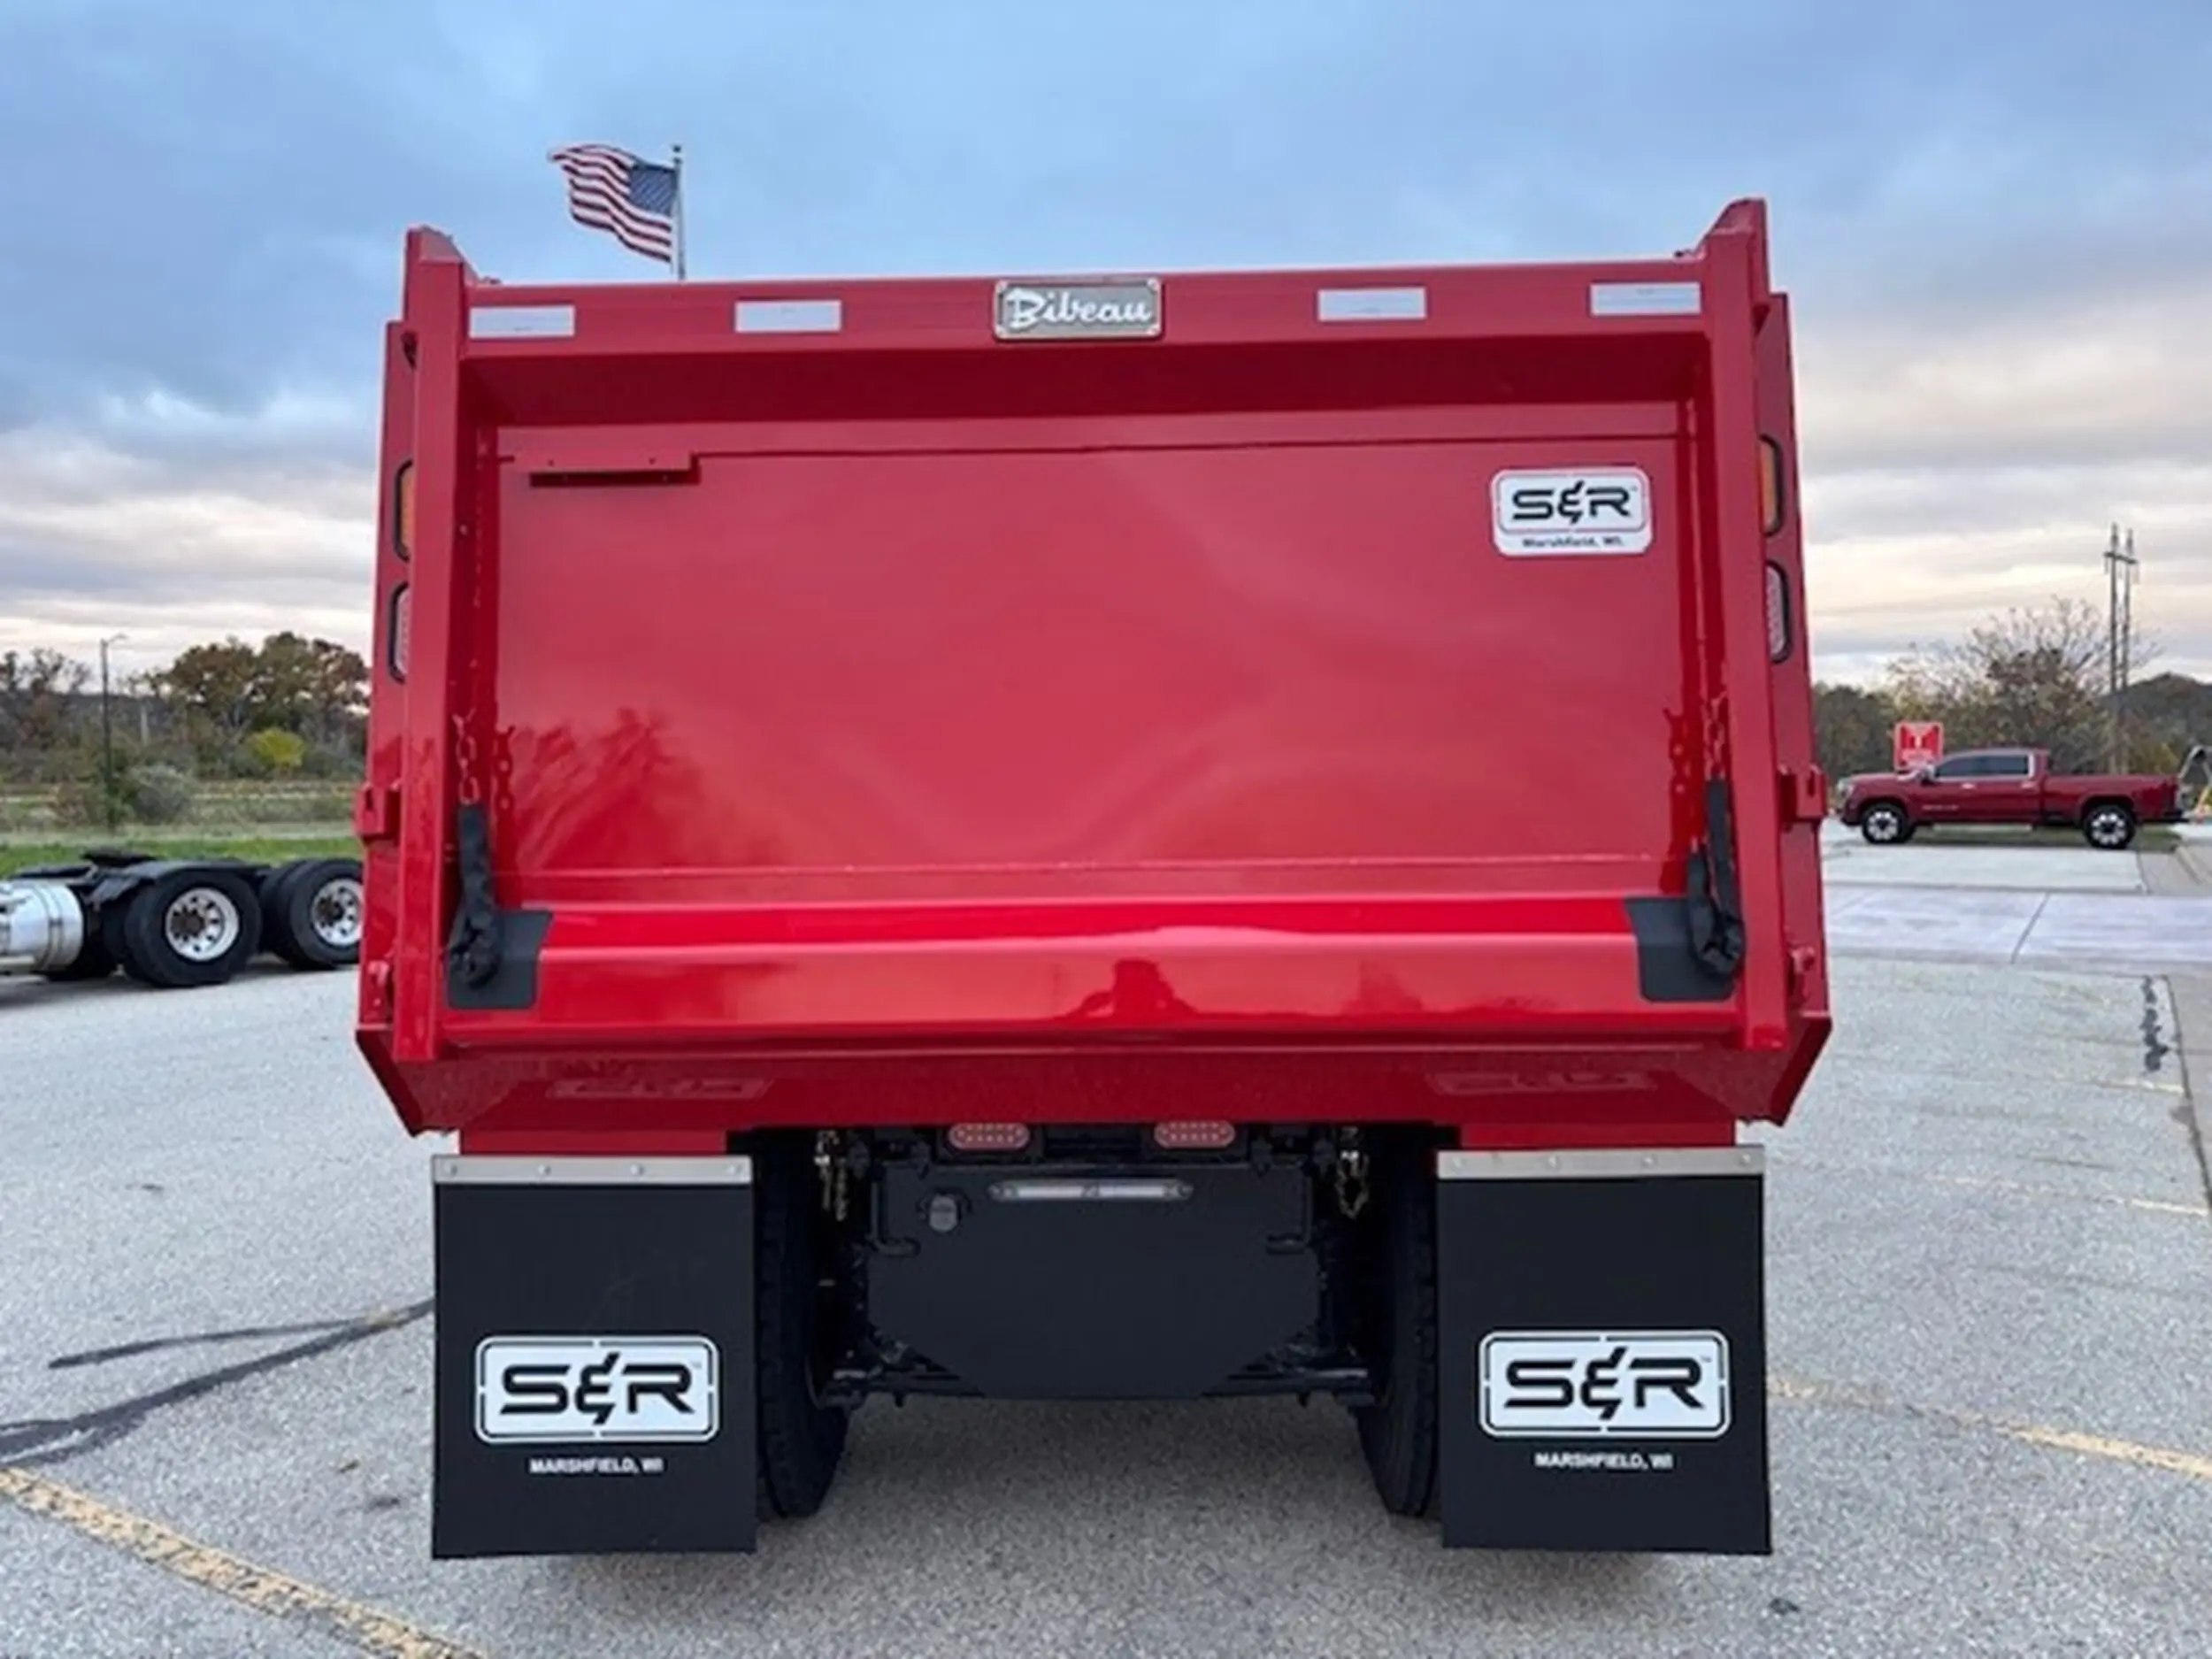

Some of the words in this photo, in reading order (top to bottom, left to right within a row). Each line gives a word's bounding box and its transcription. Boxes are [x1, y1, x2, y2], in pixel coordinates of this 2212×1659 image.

[1005, 288, 1152, 329] Bibeau
[1512, 480, 1631, 525] S&R
[500, 1351, 695, 1425] S&R
[1504, 1345, 1705, 1420] S&R
[530, 1457, 639, 1474] MARSHFIELD,
[640, 1457, 664, 1473] WI
[1534, 1452, 1648, 1471] MARSHFIELD,
[1649, 1453, 1673, 1470] WI
